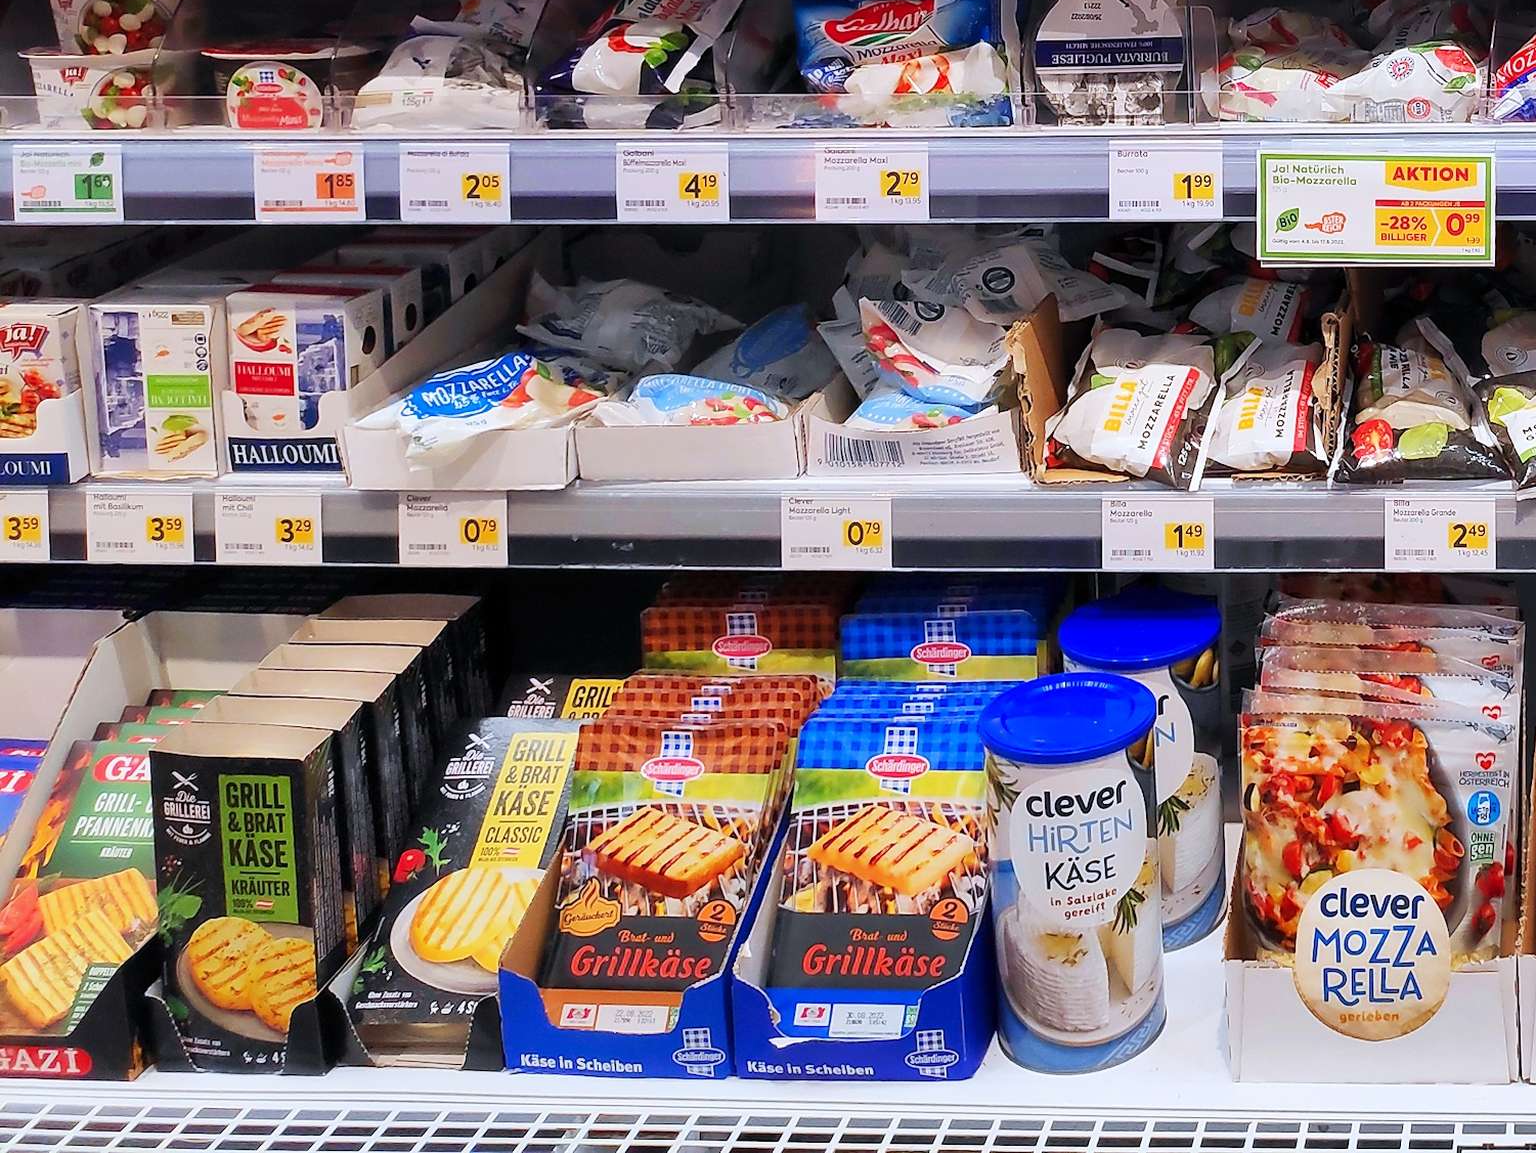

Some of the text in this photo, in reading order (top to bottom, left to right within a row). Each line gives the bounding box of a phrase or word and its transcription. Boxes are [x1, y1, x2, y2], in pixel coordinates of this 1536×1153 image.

[1117, 150, 1148, 158] Burrata
[1272, 175, 1357, 186] Bio-Mozzarella
[1392, 166, 1469, 181] AKTION
[1380, 216, 1427, 230] -28%
[1380, 233, 1427, 242] BILLIGER
[421, 356, 529, 408] MOZZARELLA
[1102, 378, 1137, 433] BILLA
[1136, 373, 1176, 450] MOZZARELLA
[1237, 386, 1264, 432] BILLA
[233, 443, 339, 465] HALLOUMI
[107, 502, 144, 511] Basilikum
[833, 506, 851, 516] Light
[1110, 509, 1152, 517] Mozzarella
[1432, 508, 1456, 517] Grande
[513, 739, 566, 762] GRILL
[505, 765, 562, 784] & BRAT
[645, 760, 703, 779] Schärdinger
[870, 757, 927, 778] Schärdinger
[225, 782, 285, 810] GRILL
[493, 786, 554, 817] KÄSE
[1025, 778, 1127, 819] clever
[163, 801, 211, 821] GRILLEREI
[228, 813, 285, 834] & BRAT
[485, 827, 541, 843] CLASSIC
[1471, 832, 1495, 843] OHNE
[229, 834, 289, 869] KÄSE
[1044, 855, 1117, 891] KÄSE
[231, 876, 290, 897] KRÄUTER
[710, 904, 725, 923] 2
[1320, 887, 1425, 920] clever
[563, 909, 615, 930] Geräuchert
[1311, 925, 1437, 968] MOZZA
[571, 946, 711, 980] Grillkäse
[802, 945, 946, 977] Grillkäse
[1323, 967, 1424, 1006] RELLA
[1339, 1011, 1400, 1024] gerieben
[520, 1054, 643, 1074] Käse in Scheiben
[747, 1060, 874, 1077] Käse in Scheiben
